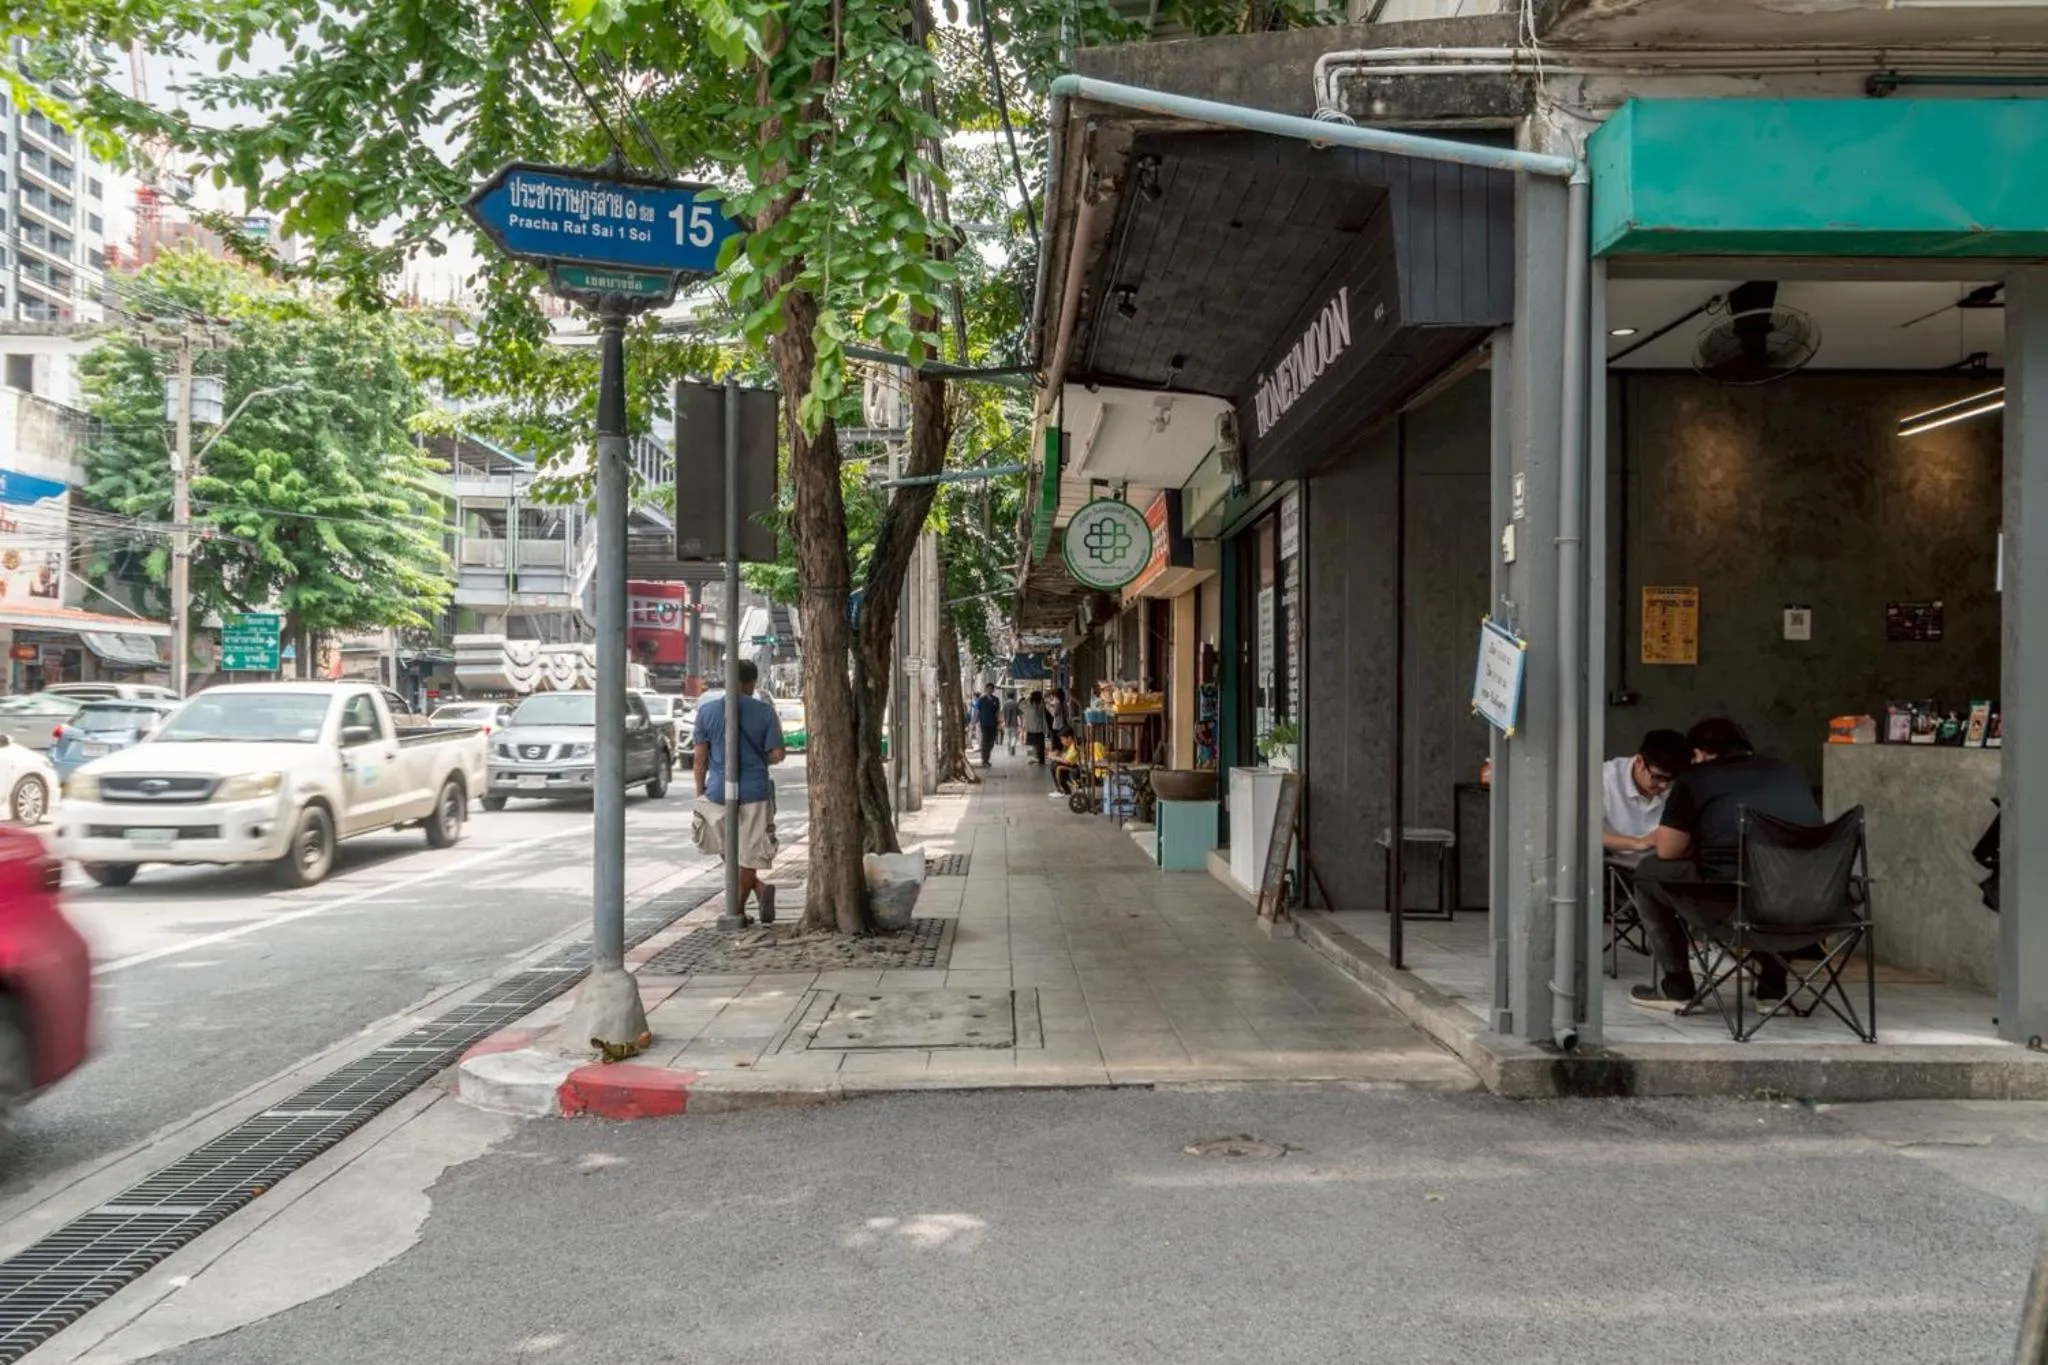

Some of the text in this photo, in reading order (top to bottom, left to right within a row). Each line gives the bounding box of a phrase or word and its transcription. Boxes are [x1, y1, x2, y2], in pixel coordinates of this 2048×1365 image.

[508, 214, 651, 242] Pracha Rat Sai 1 Soi
[668, 204, 714, 247] 15
[1254, 286, 1351, 438] HONEYMOON
